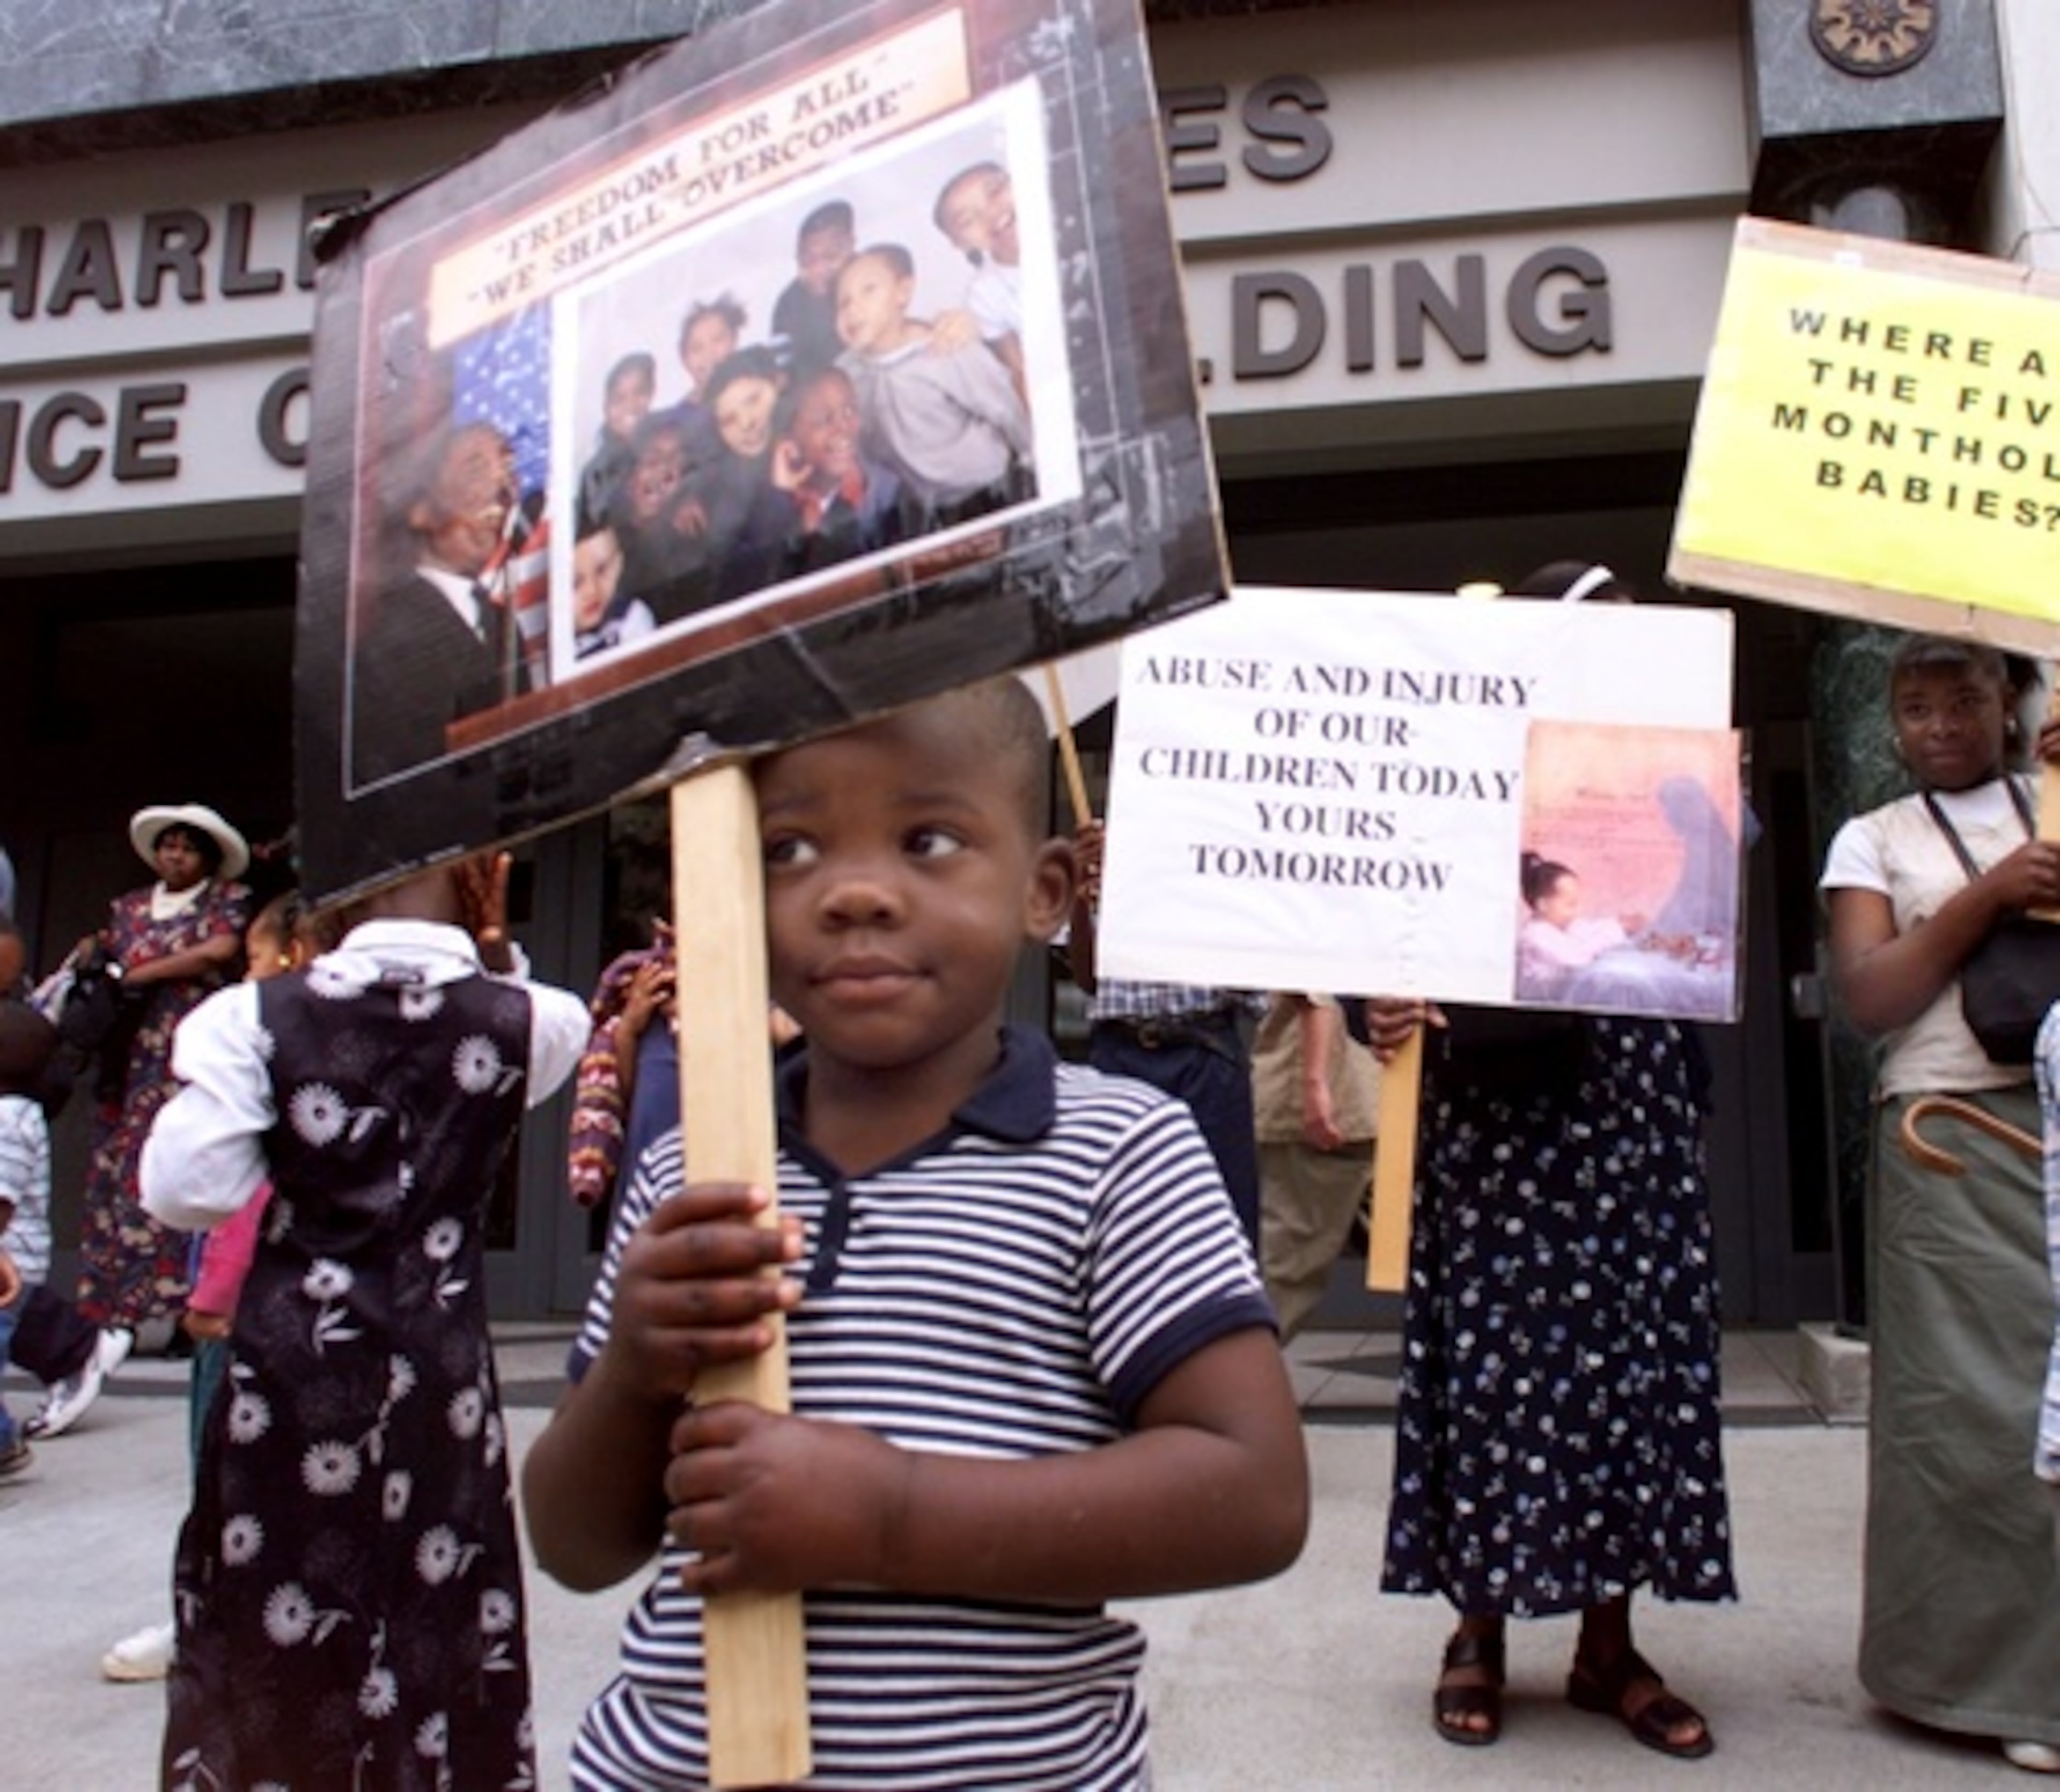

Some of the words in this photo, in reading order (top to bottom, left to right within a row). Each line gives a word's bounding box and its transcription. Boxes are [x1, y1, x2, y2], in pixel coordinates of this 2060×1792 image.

[700, 111, 770, 163] FOR
[550, 202, 664, 272] SHALL
[1197, 245, 1614, 385] DING
[1790, 308, 1993, 367] WHERE
[1808, 358, 1918, 403] THE
[1957, 386, 2052, 427] FIV
[1816, 460, 2060, 531] BABIES?
[1137, 657, 1272, 692] ABUSE
[1284, 666, 1370, 698] AND
[1383, 670, 1536, 707] INJURY
[1254, 708, 1310, 738] OF
[1321, 712, 1409, 746] OUR
[1139, 748, 1358, 790] CHILDREN
[1370, 761, 1520, 802] TODAY
[1255, 801, 1396, 840] YOURS
[1188, 844, 1453, 891] TOMORROW
